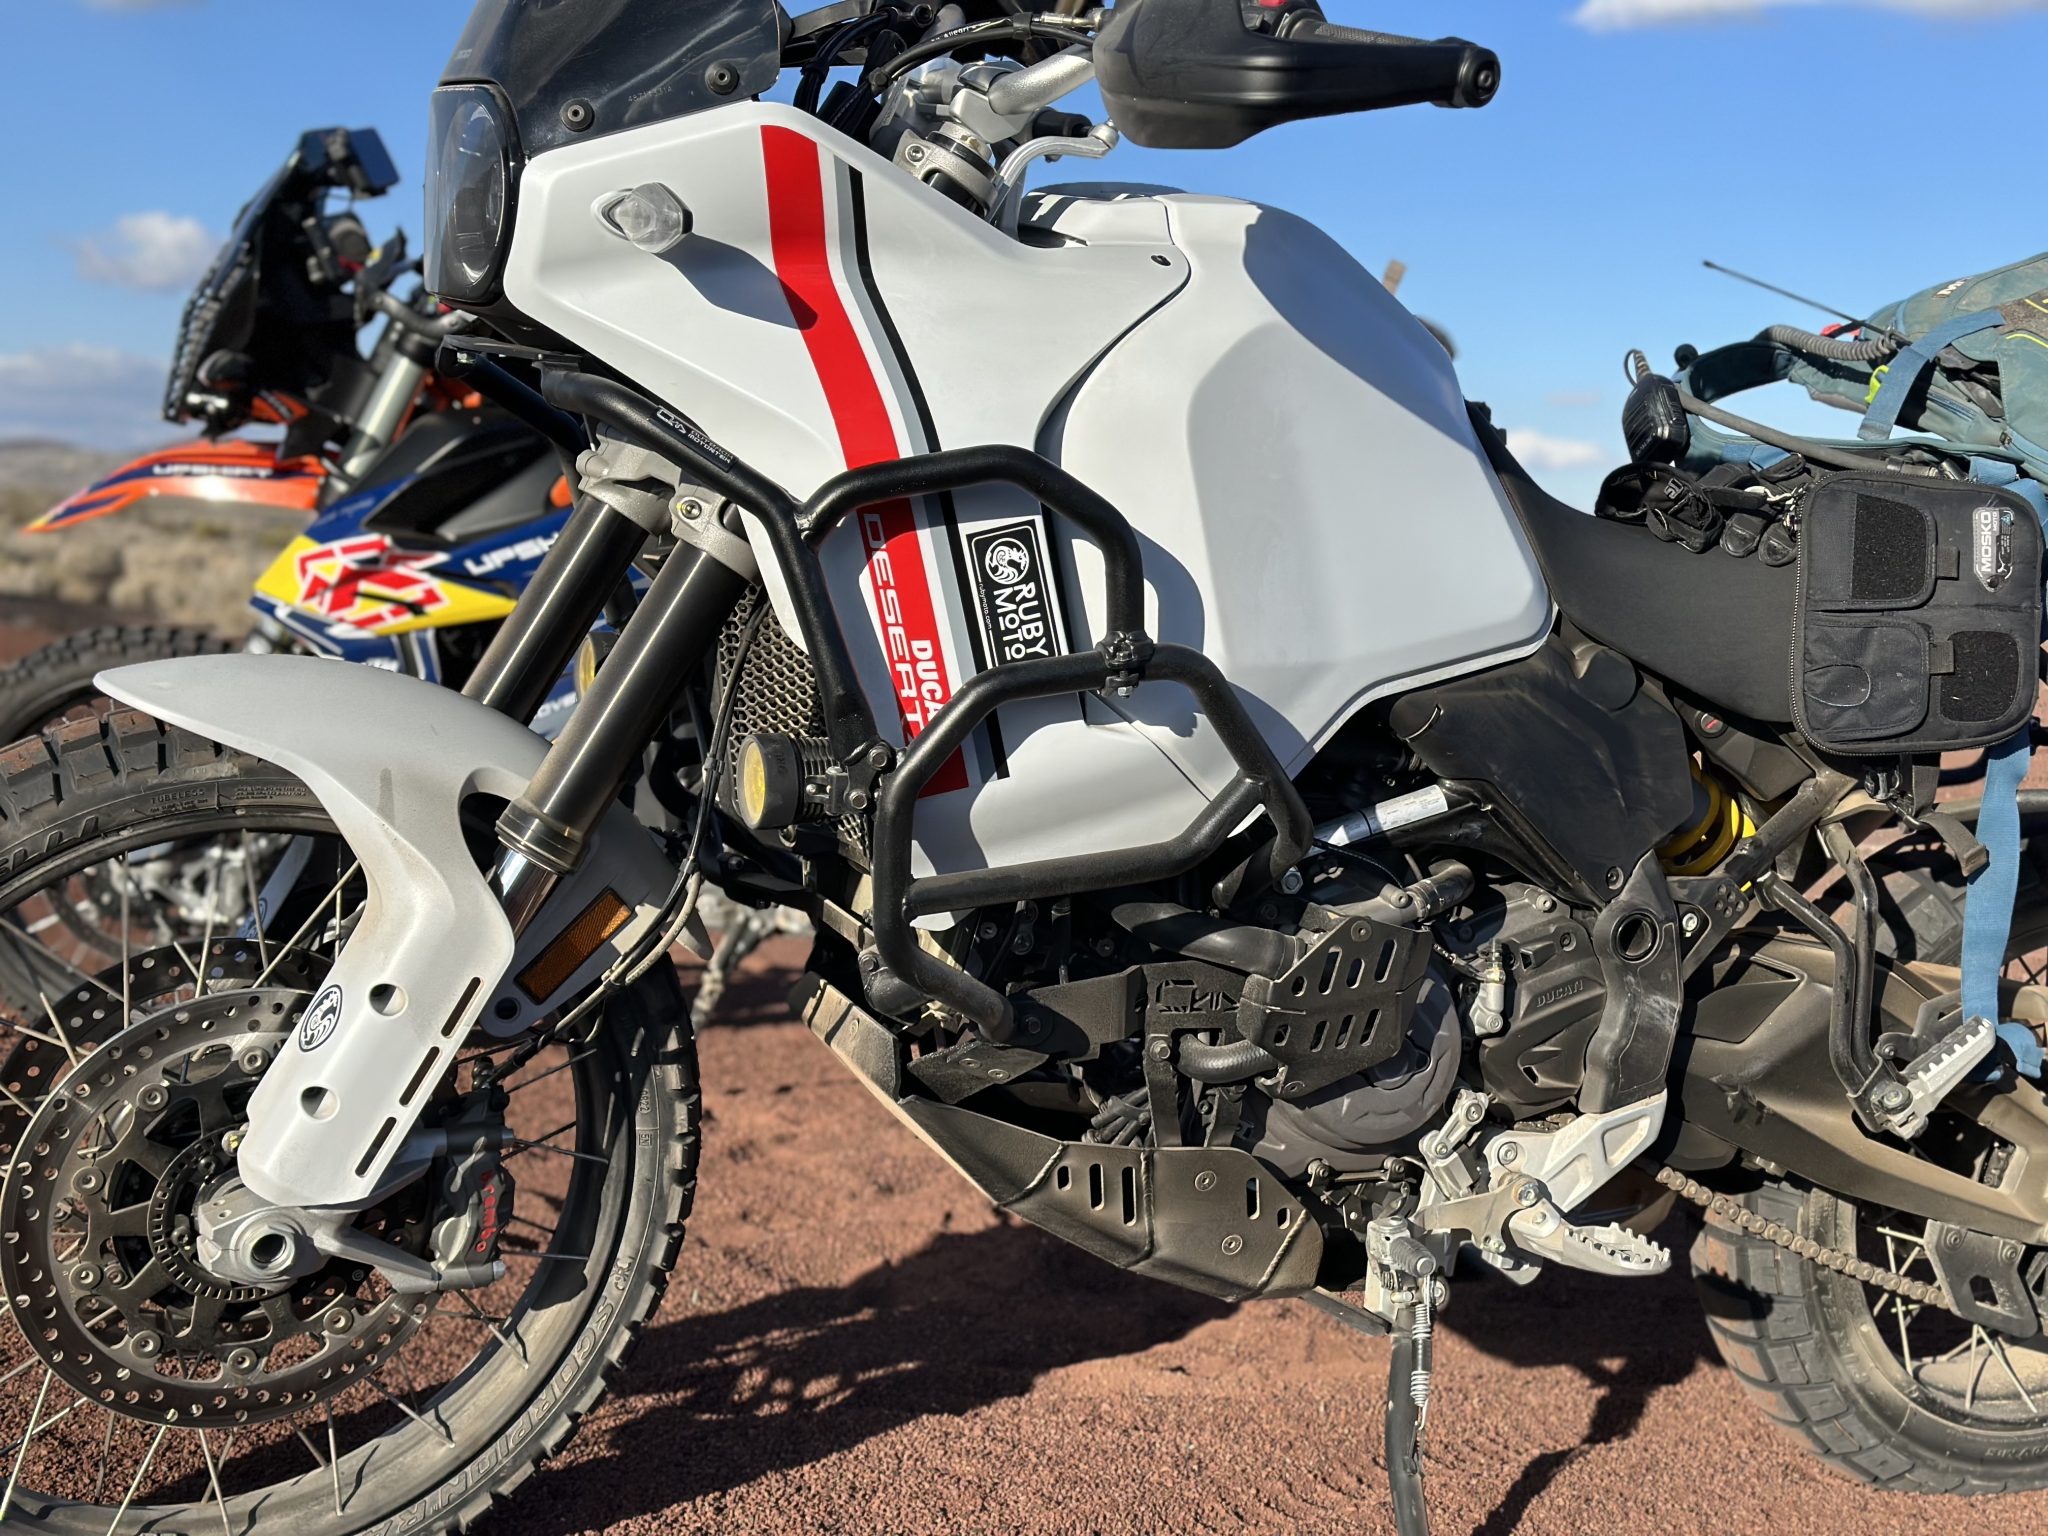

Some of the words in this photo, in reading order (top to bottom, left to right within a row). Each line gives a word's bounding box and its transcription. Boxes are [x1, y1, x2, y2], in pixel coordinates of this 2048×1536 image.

[462, 531, 560, 576] UPSH
[1980, 511, 1992, 572] MOSKO
[863, 513, 926, 733] DESERT
[1013, 581, 1049, 657] RUBY
[910, 639, 944, 723] DUCA
[1536, 979, 1585, 1008] DUCATI
[439, 1295, 613, 1509] SCORPION
